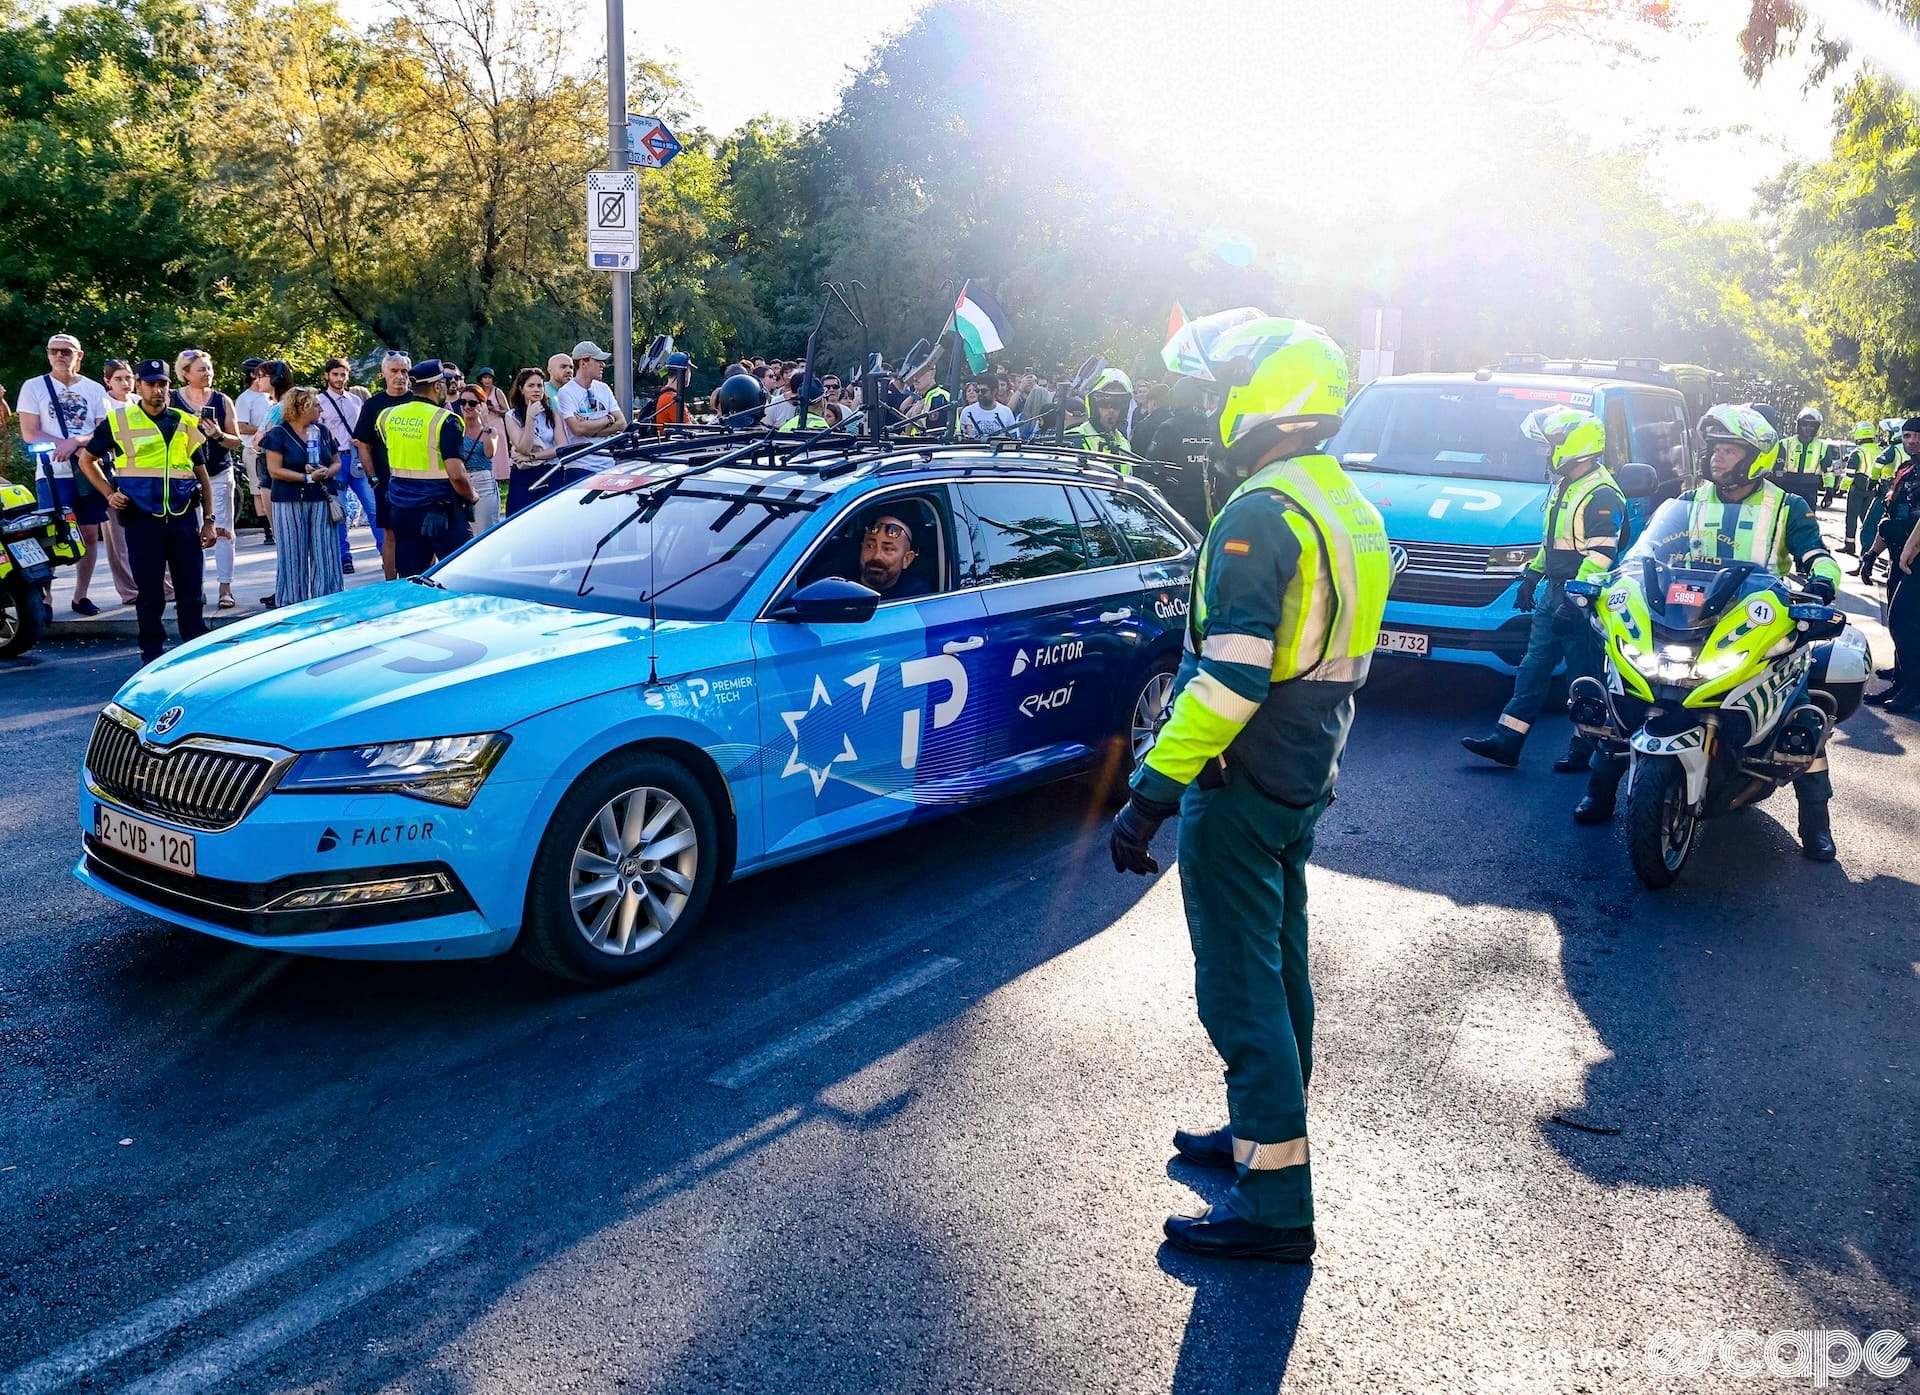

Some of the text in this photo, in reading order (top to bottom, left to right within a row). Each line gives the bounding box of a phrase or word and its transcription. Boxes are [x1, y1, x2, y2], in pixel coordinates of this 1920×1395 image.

[1608, 592, 1628, 606] 235
[1674, 592, 1695, 603] 5099
[1154, 601, 1177, 619] Chit
[1754, 605, 1769, 619] 41
[1035, 641, 1084, 668] FACTOR
[712, 676, 753, 692] PREMIER
[715, 691, 740, 704] TECH
[352, 822, 434, 846] FACTOR
